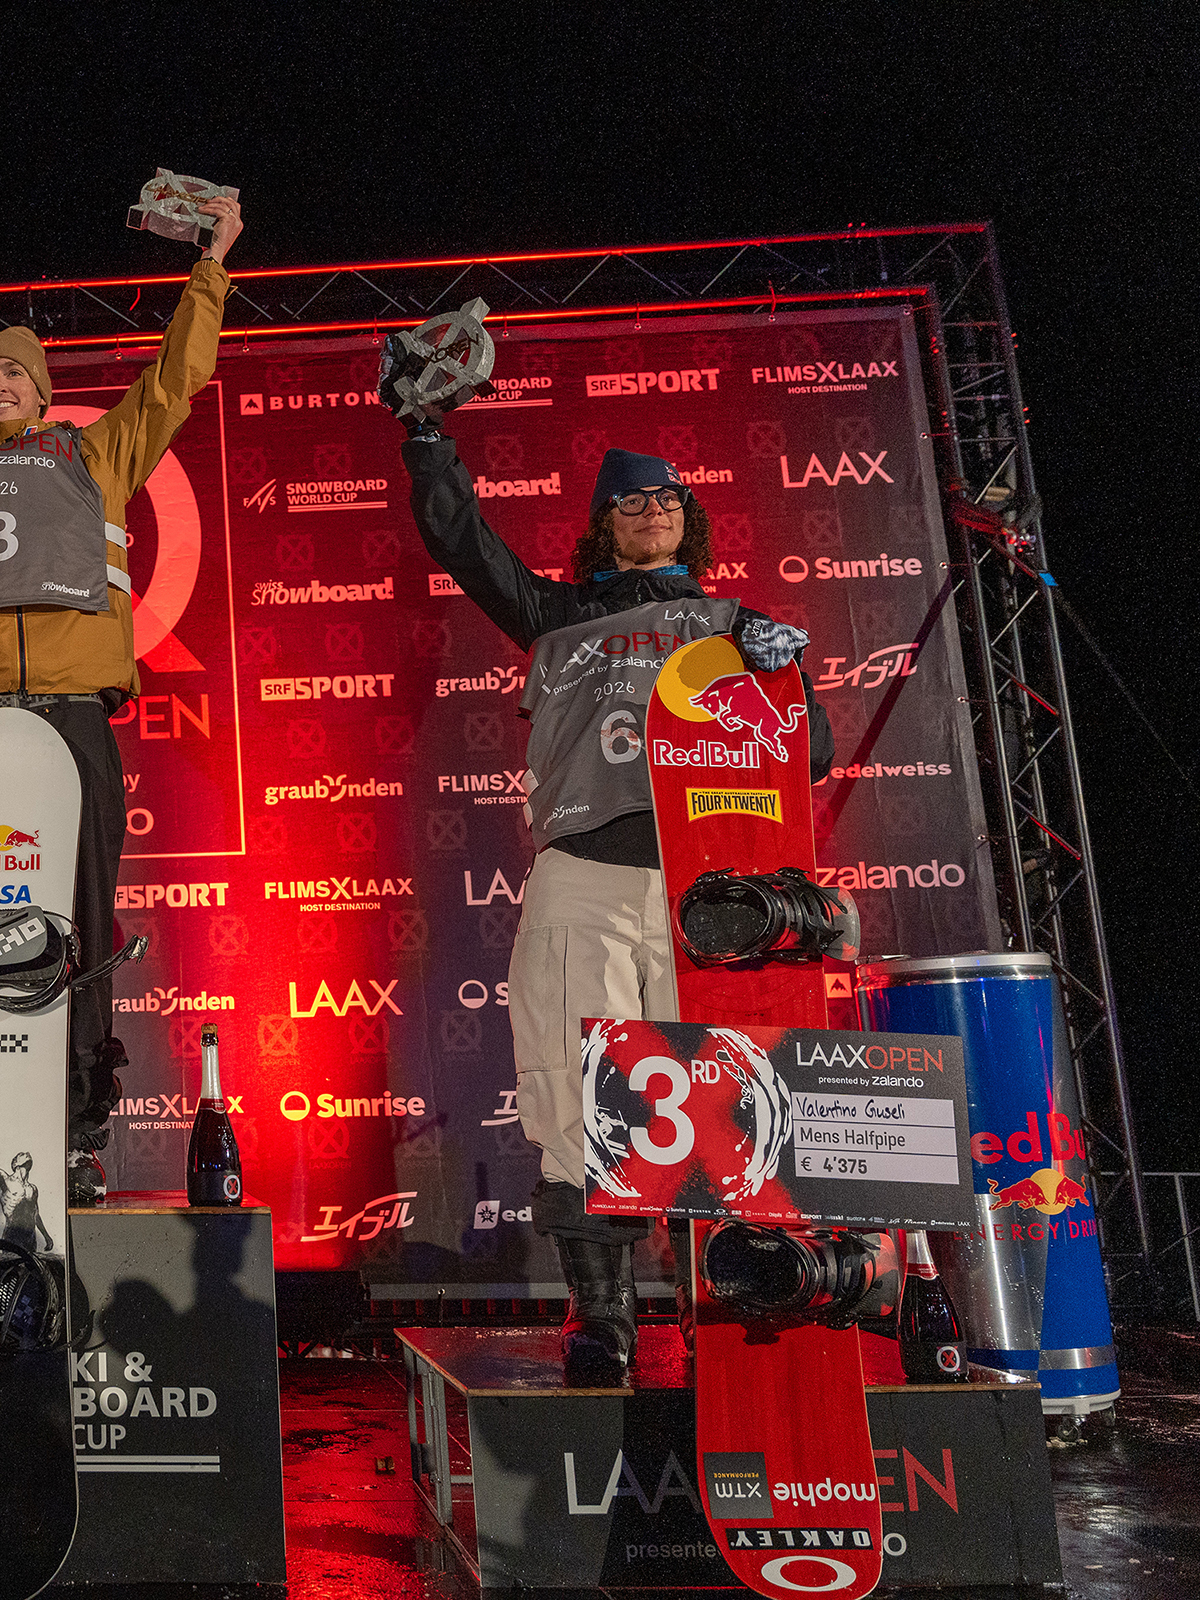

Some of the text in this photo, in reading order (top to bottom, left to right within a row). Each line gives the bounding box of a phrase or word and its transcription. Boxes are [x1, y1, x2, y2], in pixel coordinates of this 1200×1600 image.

[590, 368, 720, 395] SRF SPORT
[788, 384, 868, 394] HOST DESTINATION
[270, 391, 380, 410] BURTON
[498, 390, 523, 401] CUP
[0, 454, 56, 469] zalando
[780, 450, 895, 489] LAAX
[286, 479, 388, 495] SNOWBOARD
[288, 492, 358, 505] WORLD CUP
[814, 553, 922, 580] Sunrise
[251, 577, 394, 606] snowboard
[254, 579, 284, 591] swiss
[664, 609, 711, 626] LAAX
[597, 664, 609, 673] by
[611, 656, 664, 669] zaland
[263, 674, 394, 700] SRF SPORT
[594, 681, 635, 702] 2026
[600, 709, 642, 764] 6
[653, 739, 760, 769] Red Bull
[831, 761, 952, 779] edelweiss
[474, 796, 528, 805] HOST DESTIN
[732, 794, 776, 817] TWENTY
[3, 854, 41, 872] Bull
[816, 860, 965, 890] zalando
[128, 882, 229, 909] SPORT
[300, 902, 381, 912] HOST DESTINATION
[289, 979, 404, 1018] LAAX
[796, 1042, 944, 1073] LAAXOPEN
[691, 1059, 721, 1085] RD
[818, 1075, 924, 1088] presented by zalando
[316, 1090, 426, 1118] Sunrise
[628, 1055, 695, 1166] 3
[796, 1097, 857, 1118] Valentino
[129, 1121, 195, 1130] HOST DESTINAT
[800, 1126, 906, 1150] Mens Halfpipe
[801, 1156, 868, 1174] € 4'375
[124, 1351, 153, 1383] &
[715, 1482, 762, 1498] XTM
[773, 1478, 876, 1507] mophie
[730, 1530, 871, 1547] OAKLEY
[626, 1540, 721, 1562] presente
